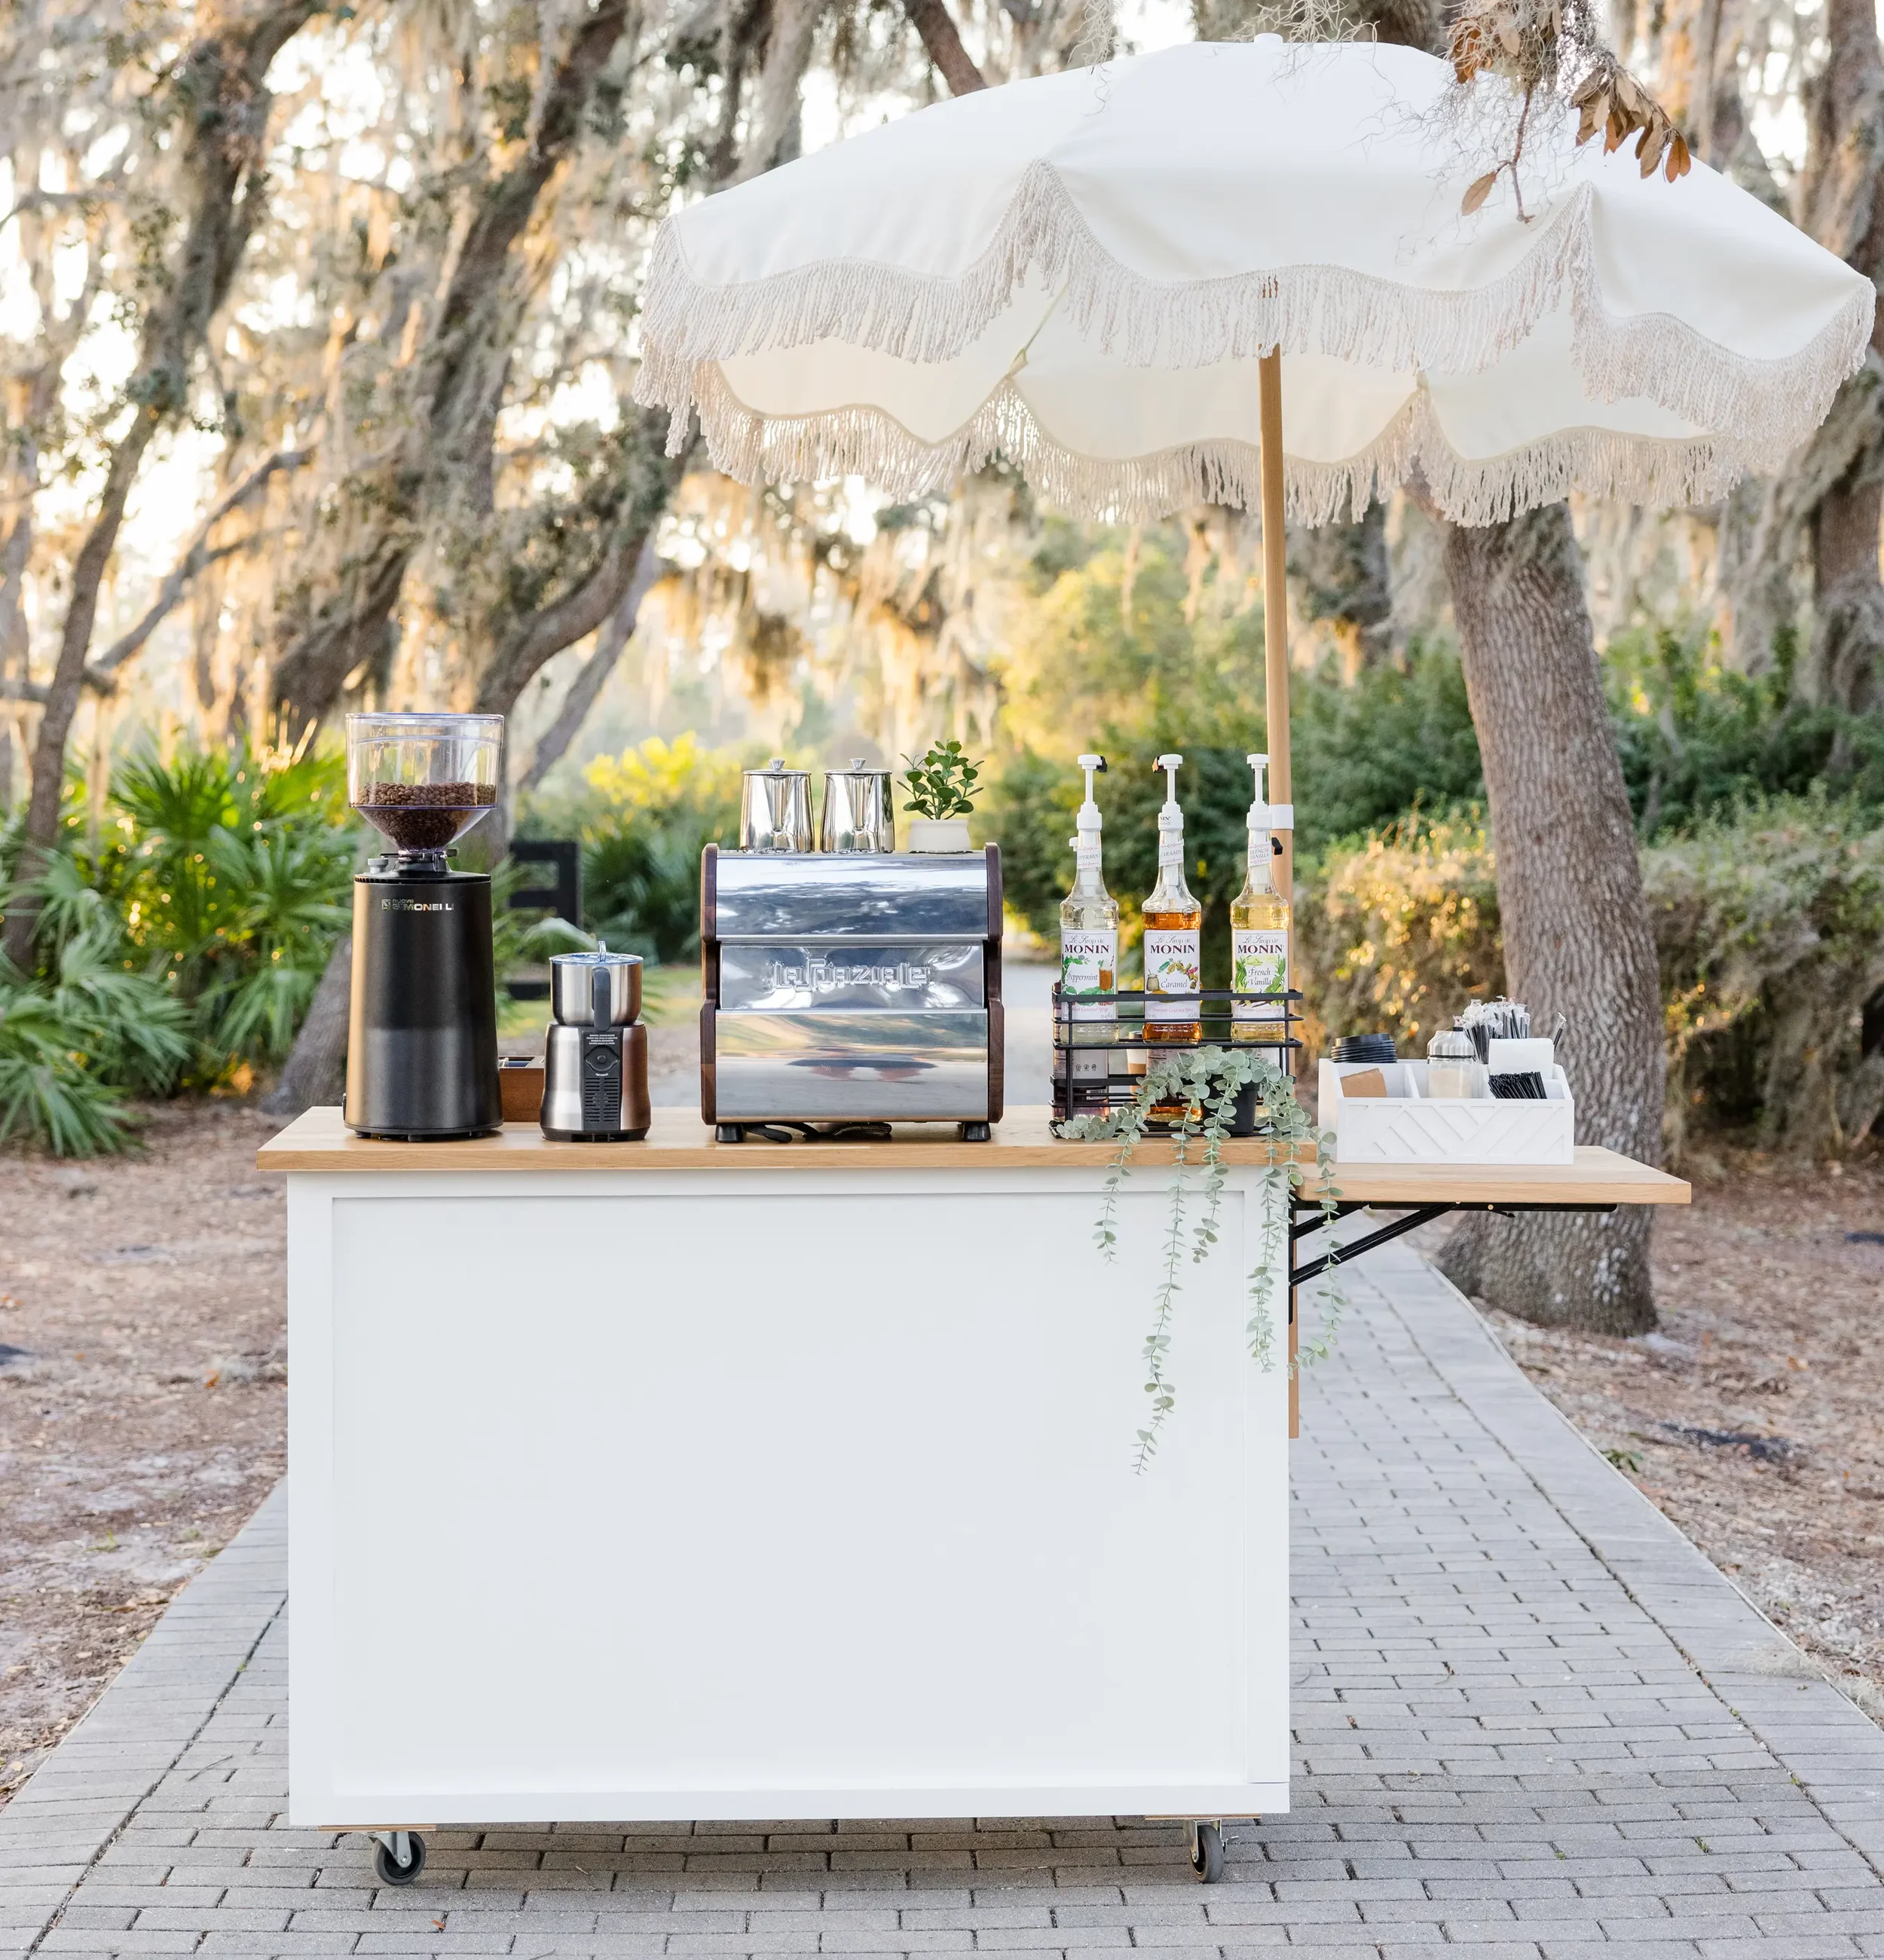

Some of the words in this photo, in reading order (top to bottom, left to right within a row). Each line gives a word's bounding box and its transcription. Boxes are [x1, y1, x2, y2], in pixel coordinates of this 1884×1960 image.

[1069, 934, 1078, 943] Le
[1155, 934, 1164, 943] Le
[1243, 934, 1252, 943] Le
[1064, 944, 1109, 954] MONIN
[1150, 944, 1195, 955] MONIN
[1237, 944, 1283, 954] MONIN
[1248, 966, 1271, 977] French
[1066, 971, 1099, 983] Peppermint
[1248, 977, 1272, 986] Vanilla
[1161, 978, 1188, 989] Caramel
